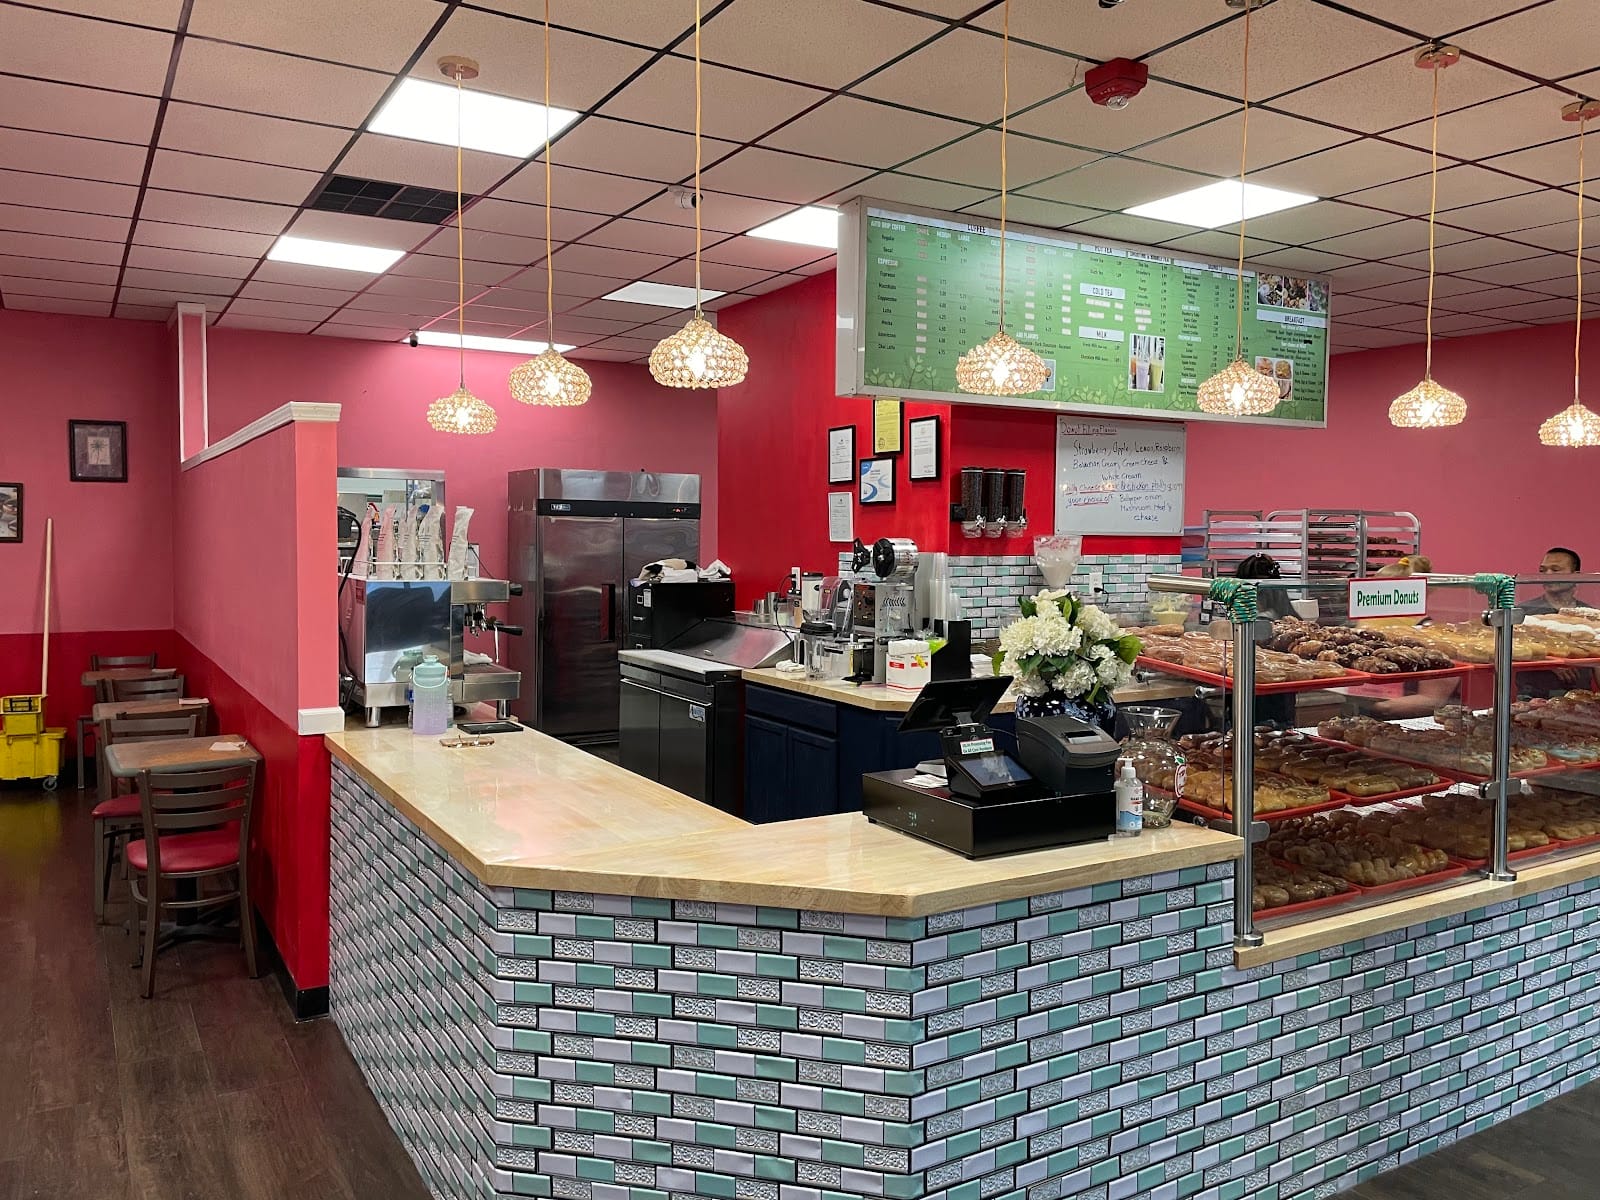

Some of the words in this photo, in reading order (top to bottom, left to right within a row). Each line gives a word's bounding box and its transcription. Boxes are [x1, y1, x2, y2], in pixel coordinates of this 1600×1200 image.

[891, 223, 906, 232] COFFEE
[967, 223, 986, 234] COFFEE
[1092, 287, 1104, 296] COLD
[1104, 289, 1113, 297] TEA
[1357, 590, 1392, 606] Premium
[1393, 589, 1419, 605] Donuts
